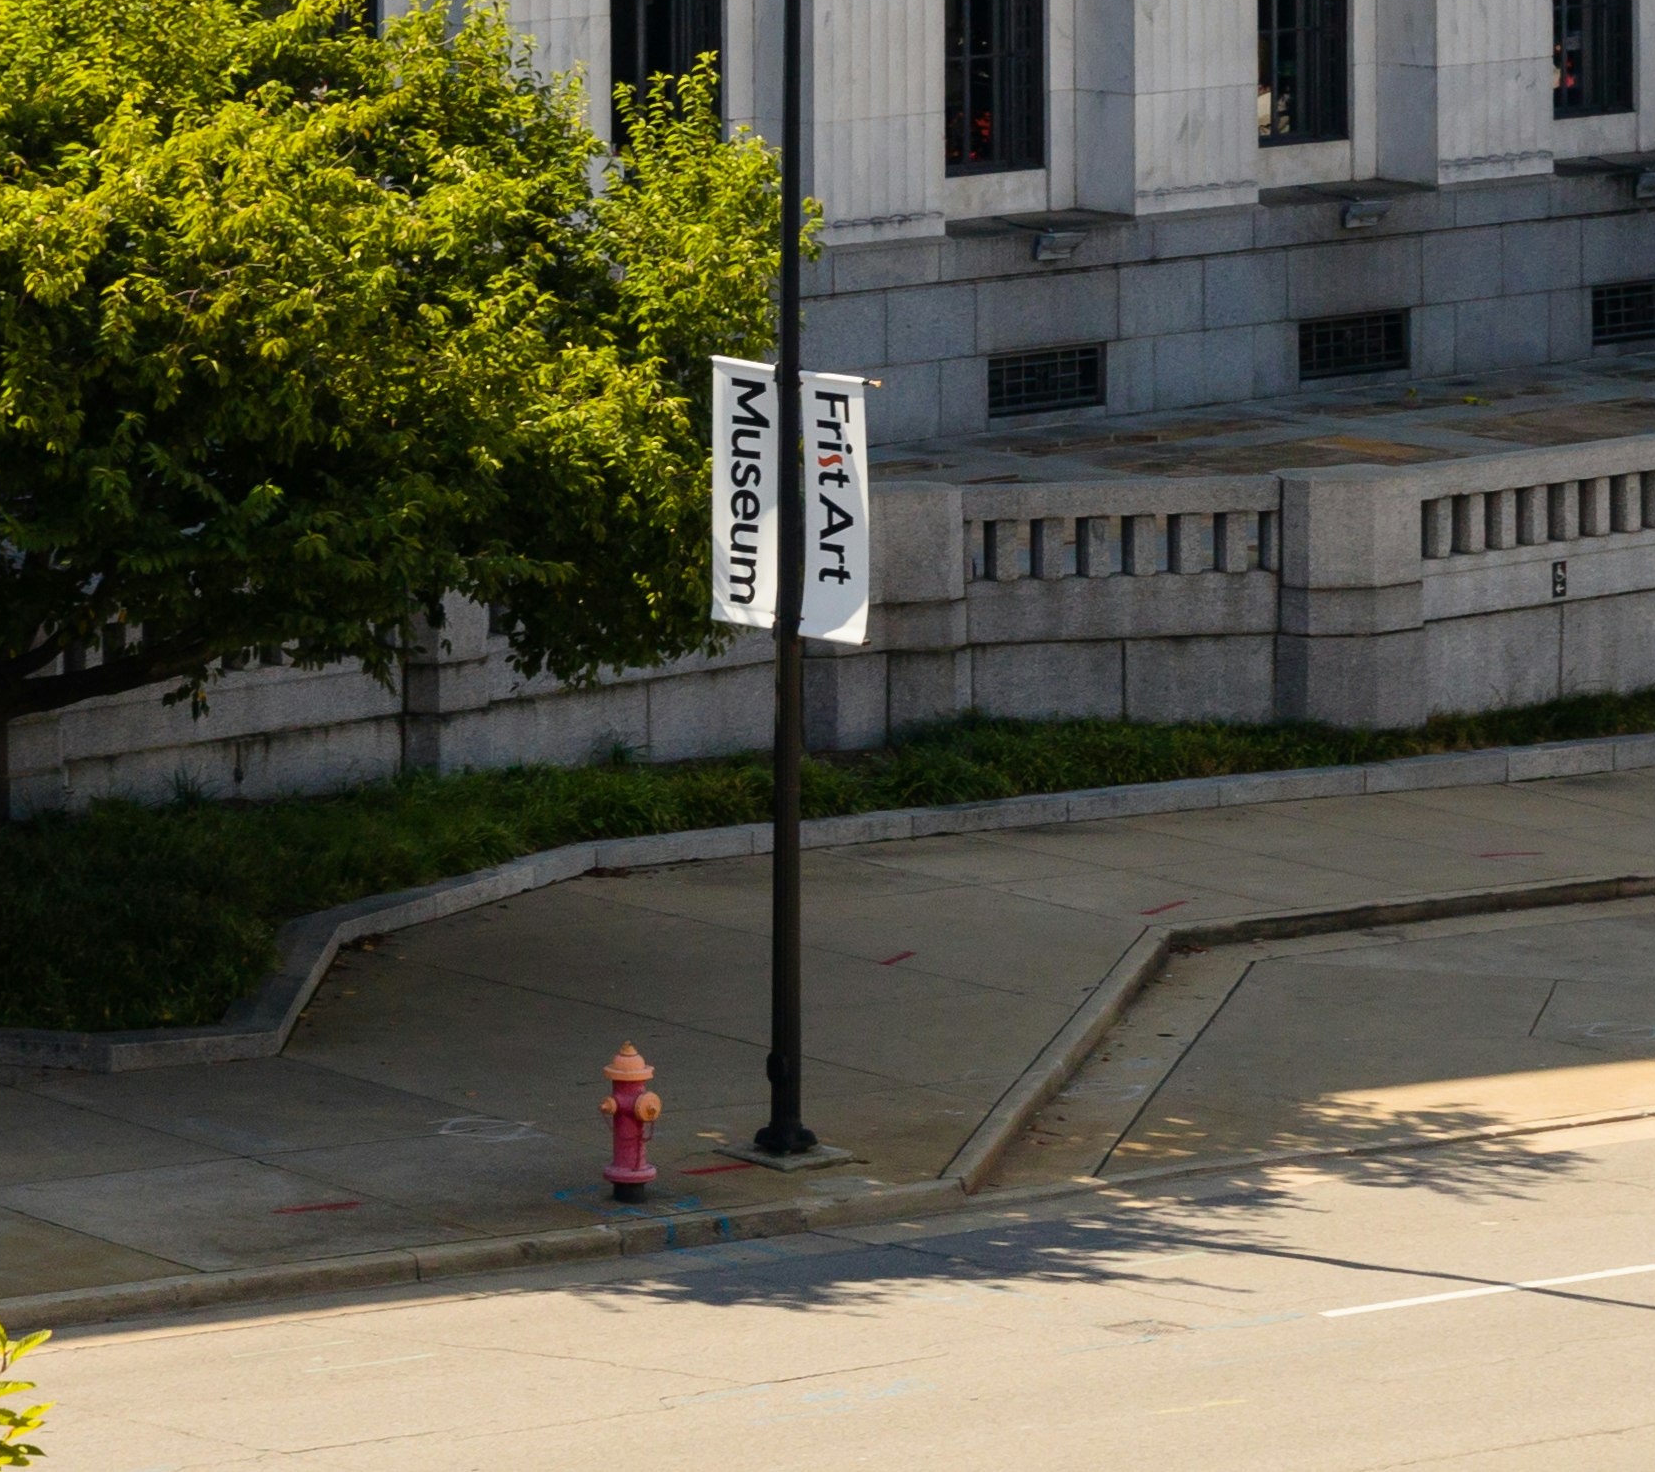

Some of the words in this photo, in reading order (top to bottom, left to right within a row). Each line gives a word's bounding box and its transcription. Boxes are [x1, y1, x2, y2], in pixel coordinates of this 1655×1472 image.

[815, 390, 853, 489] Frist
[729, 377, 771, 605] Museum
[818, 492, 854, 585] Art
